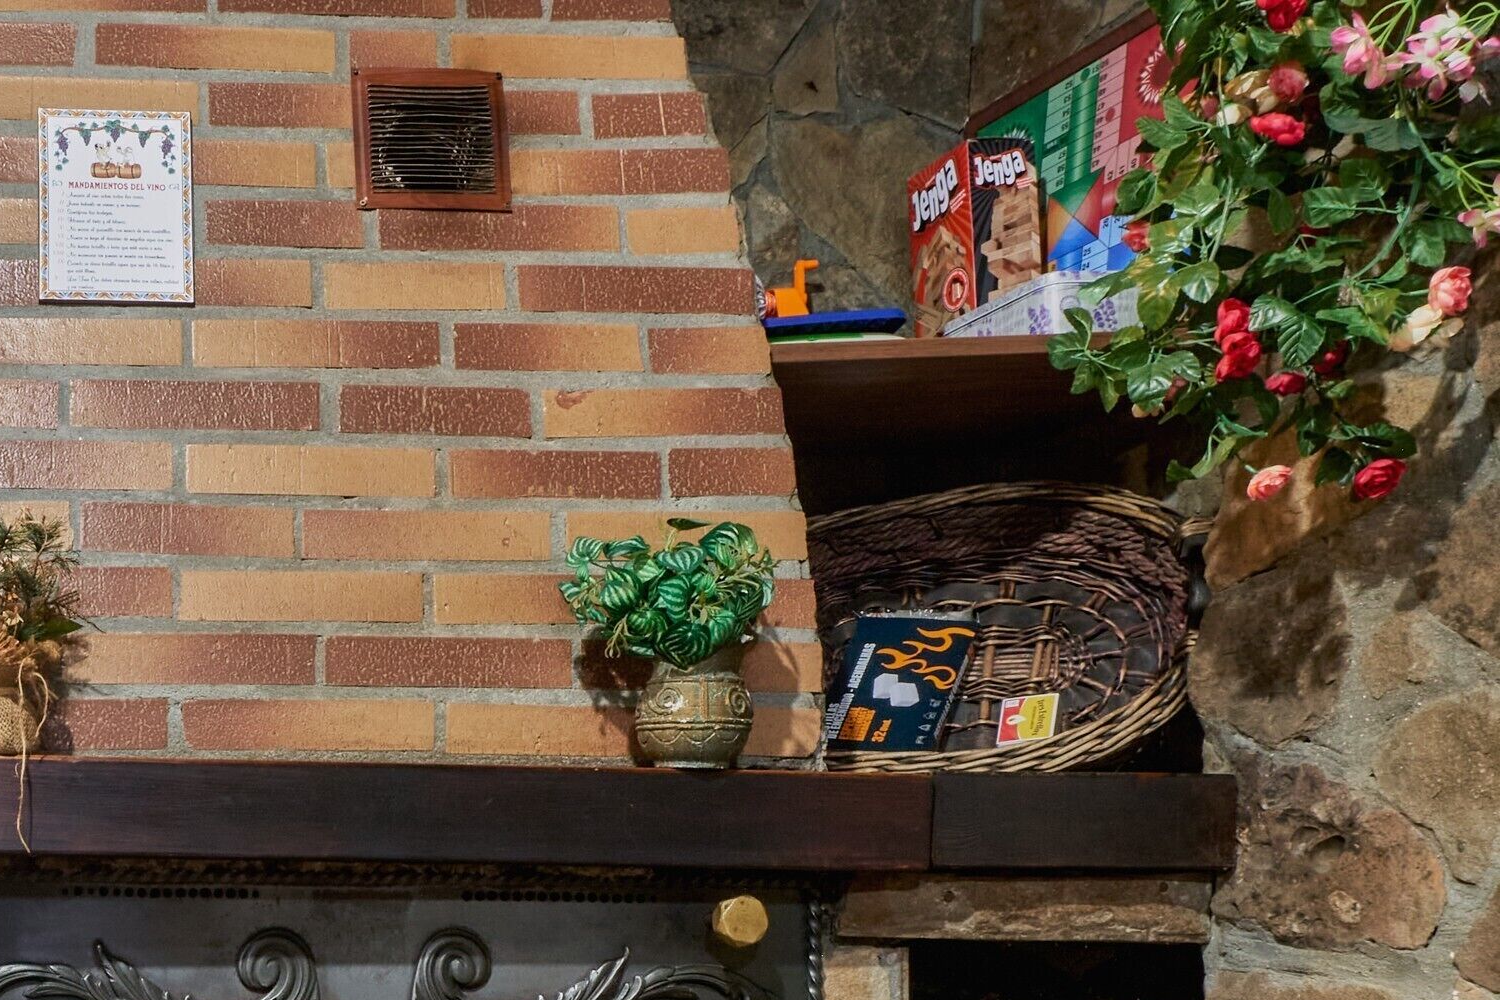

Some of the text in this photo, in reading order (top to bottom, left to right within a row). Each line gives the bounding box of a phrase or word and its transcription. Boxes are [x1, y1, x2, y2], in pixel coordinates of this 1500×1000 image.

[974, 151, 1026, 186] Jenga
[68, 181, 128, 190] MANDAMIENTOS
[912, 159, 958, 232] Jenga
[1083, 247, 1091, 256] 25
[1082, 262, 1089, 271] 24
